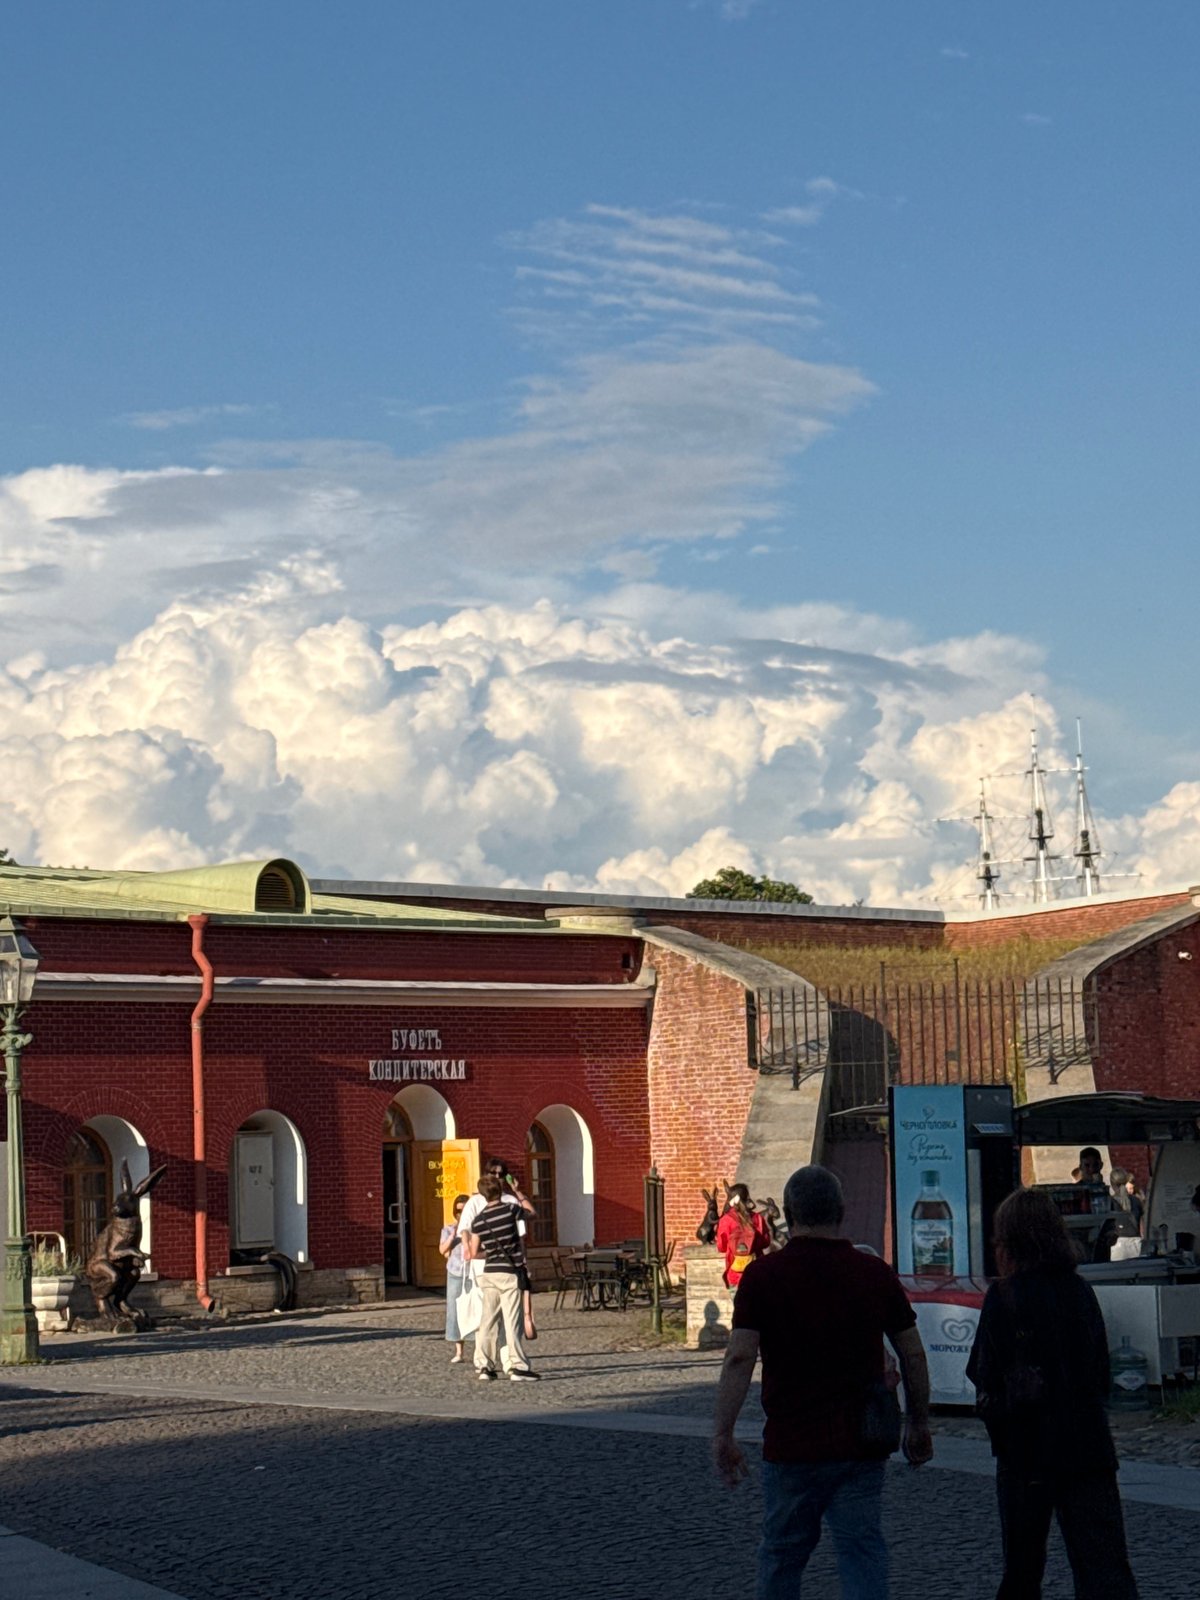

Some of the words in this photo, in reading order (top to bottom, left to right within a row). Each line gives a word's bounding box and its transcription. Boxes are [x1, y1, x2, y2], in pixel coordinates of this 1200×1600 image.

[391, 1029, 442, 1050] БУФЕТЪ
[368, 1059, 466, 1082] КОНДИТЕРСКАЯ
[930, 1344, 970, 1353] МОРОЖЕ
